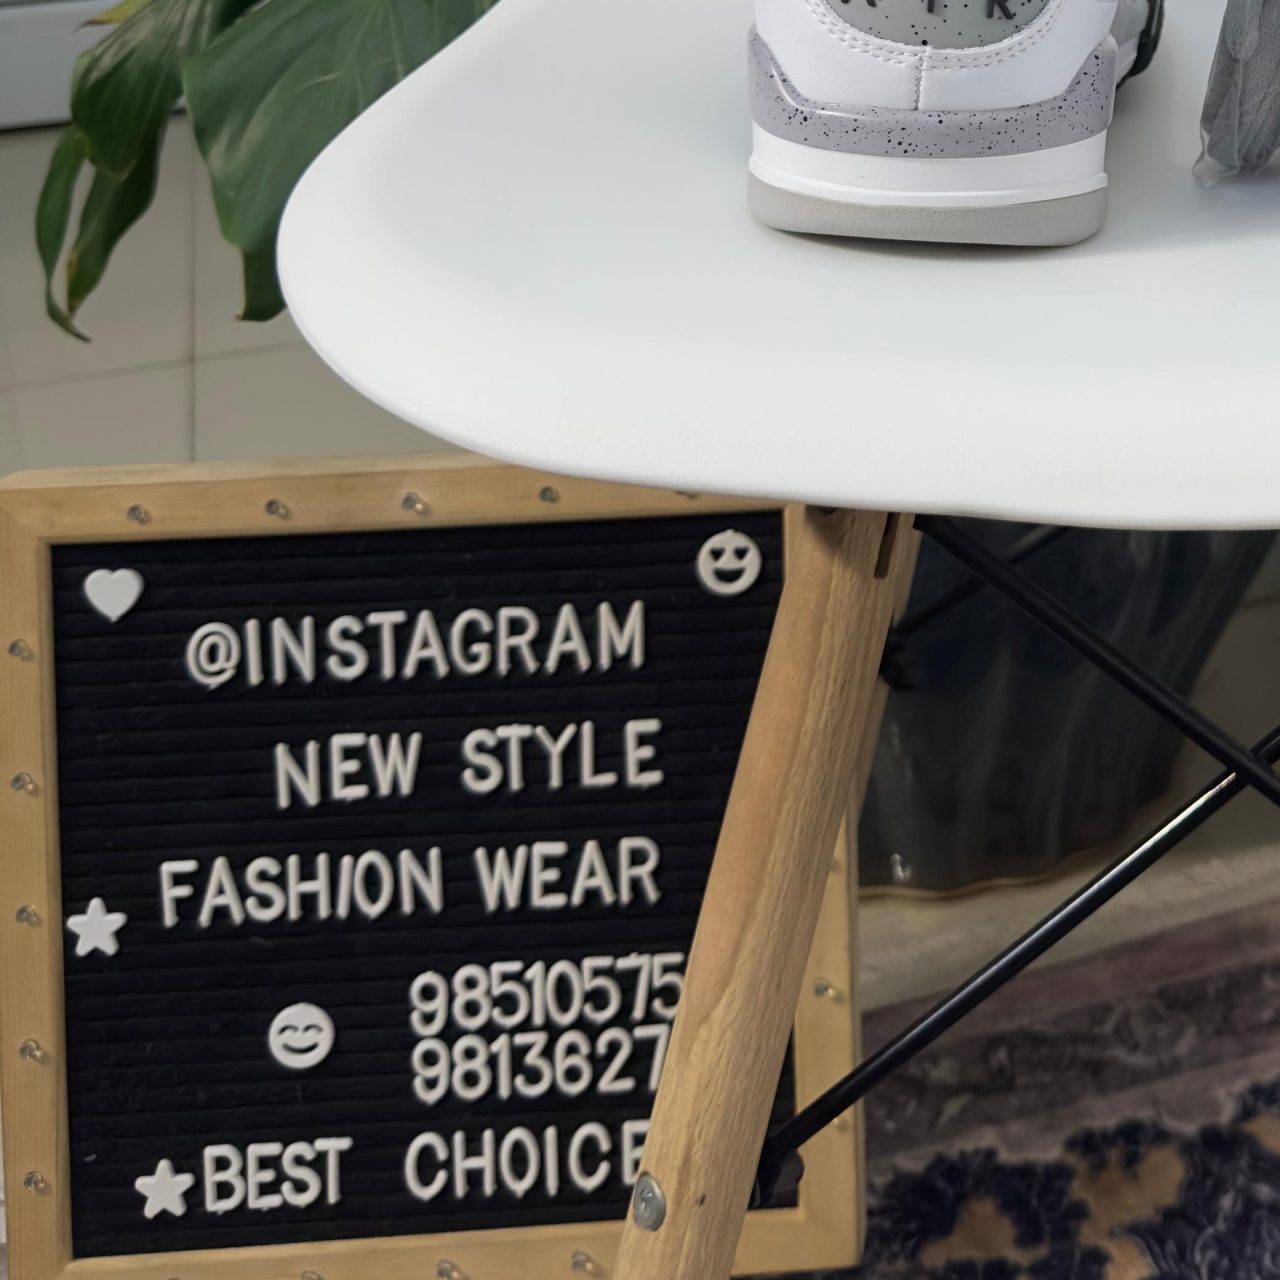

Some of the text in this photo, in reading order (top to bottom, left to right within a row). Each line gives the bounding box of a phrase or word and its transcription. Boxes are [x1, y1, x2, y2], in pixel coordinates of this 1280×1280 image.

[186, 600, 645, 689] @INSTAGRAM
[274, 718, 663, 808] NEW STYLE
[159, 836, 660, 927] FASHION WEAR
[203, 1120, 651, 1214] BEST CHOICE
